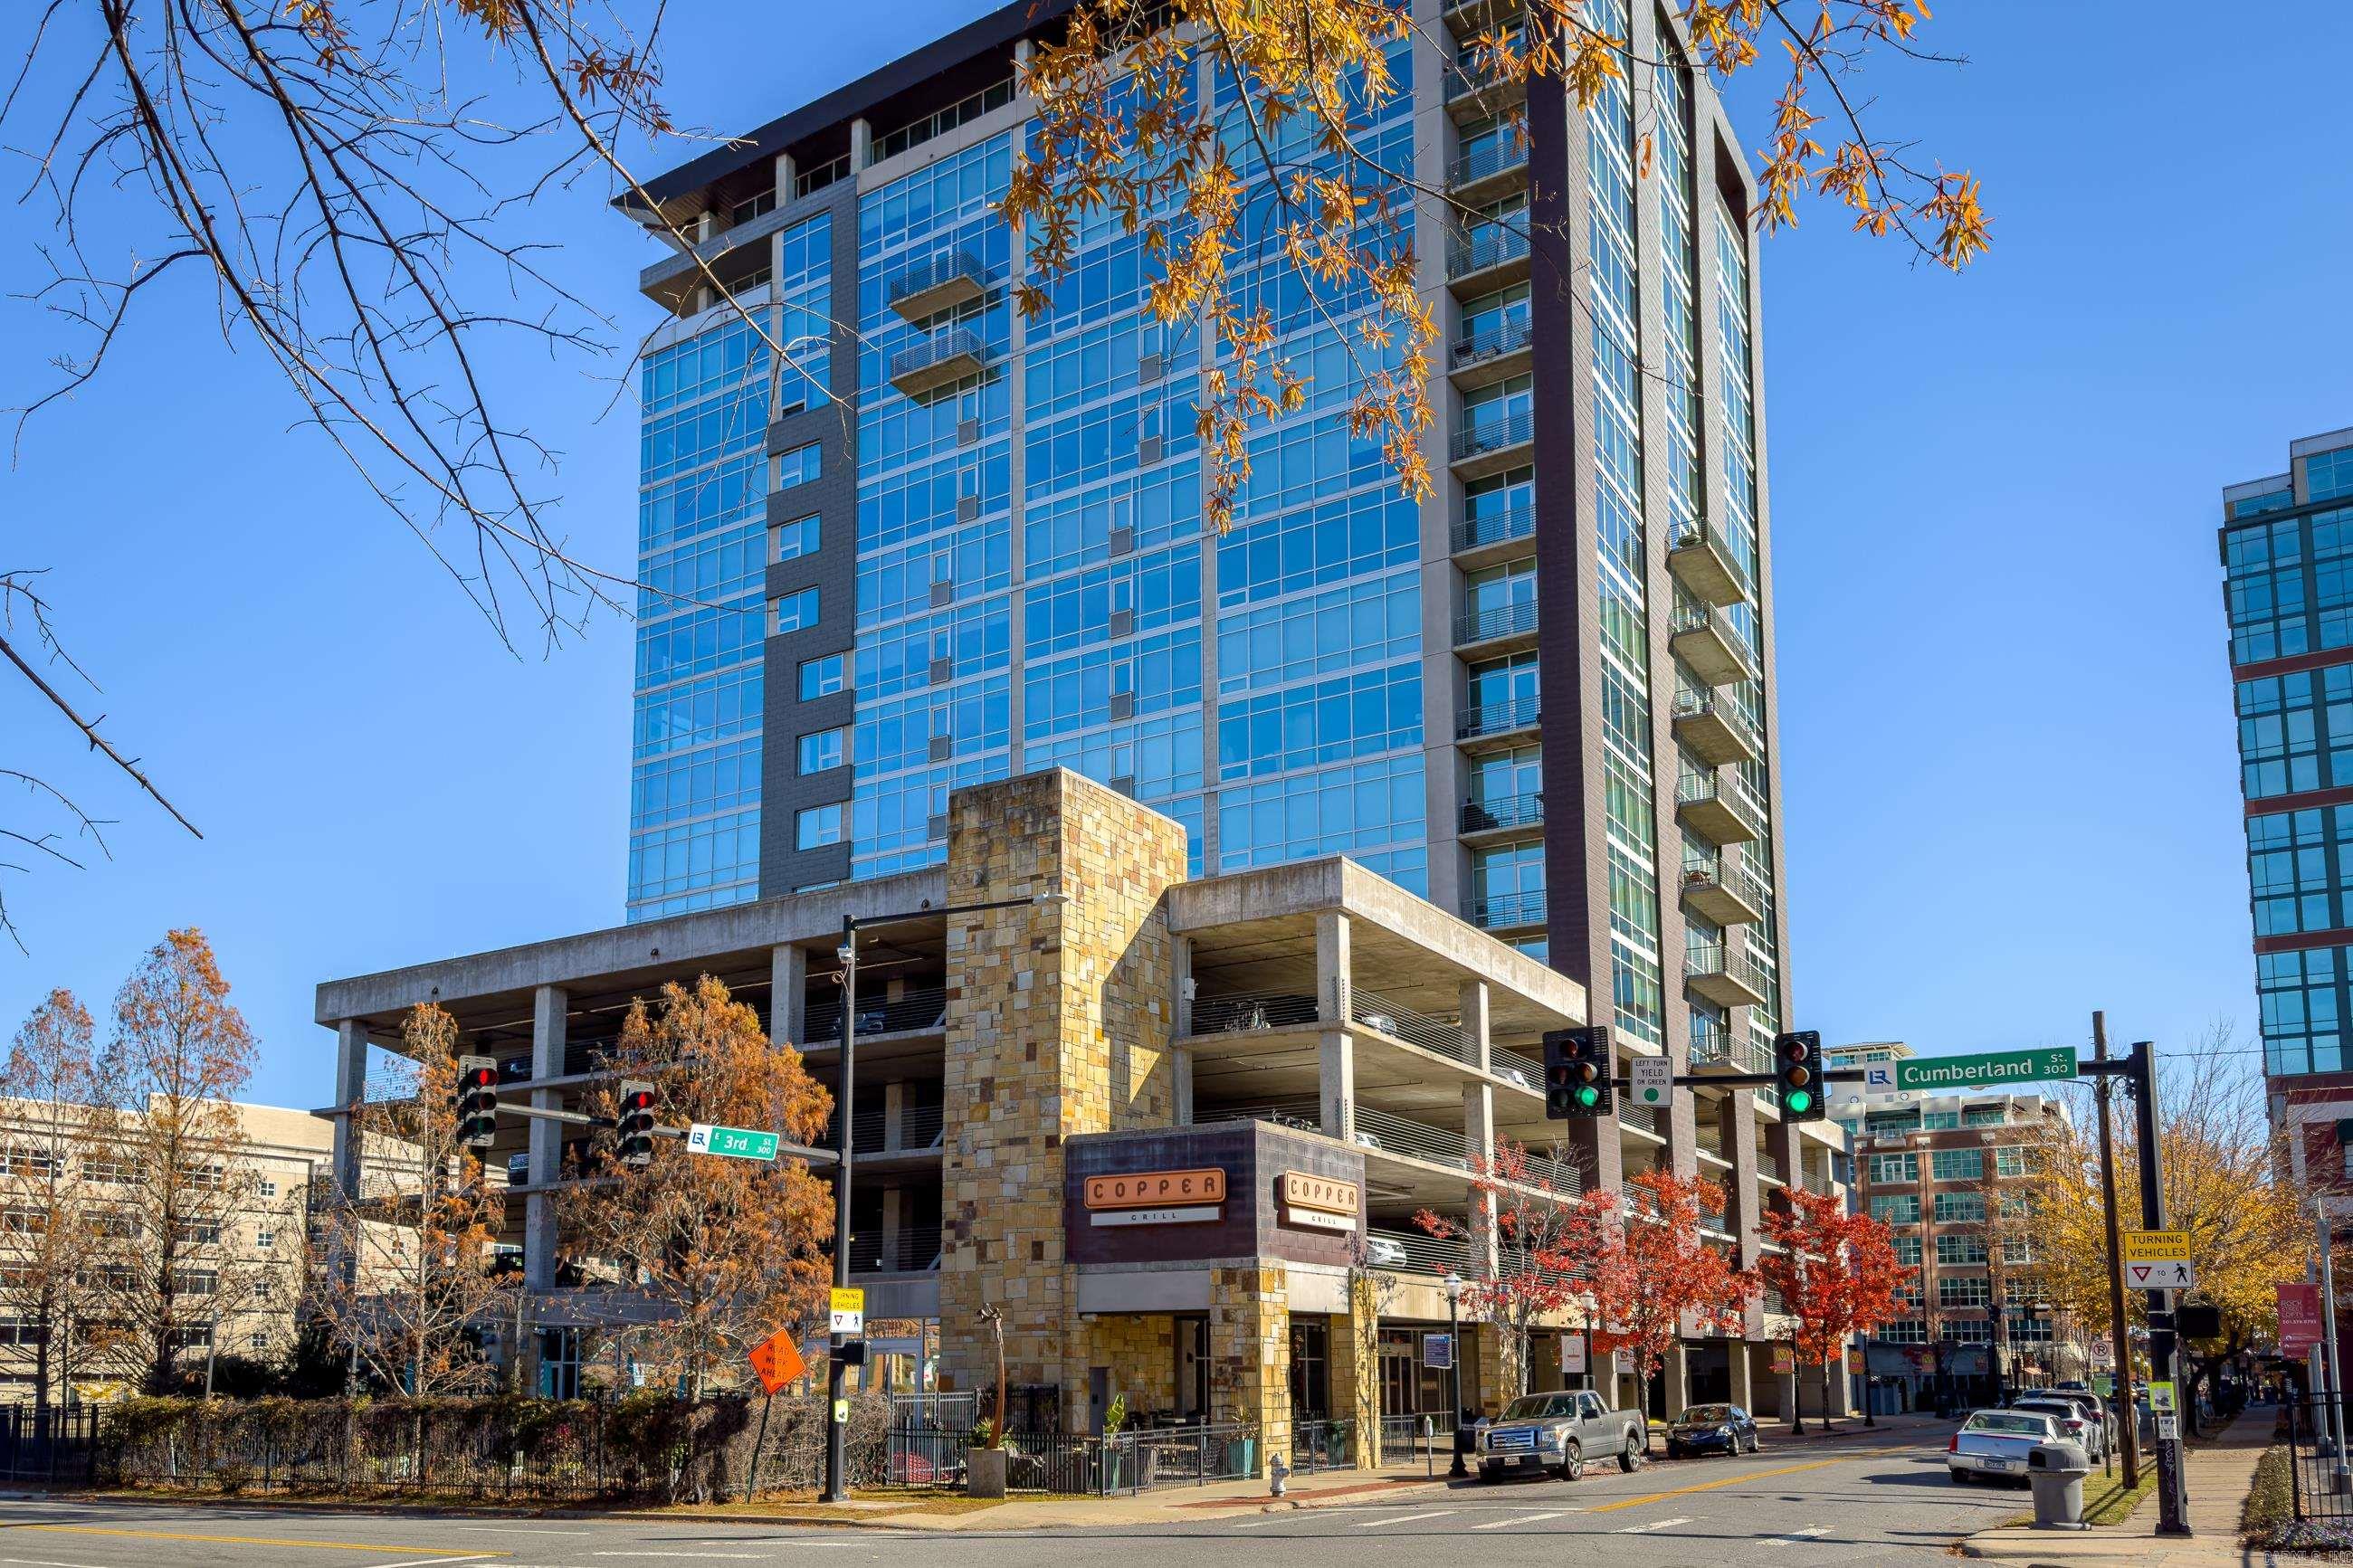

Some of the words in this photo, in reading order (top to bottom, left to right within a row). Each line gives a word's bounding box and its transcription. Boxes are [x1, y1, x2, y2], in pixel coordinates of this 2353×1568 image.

[2050, 1053, 2069, 1063] St.
[1641, 1069, 1663, 1077] YIELD
[1904, 1059, 2034, 1083] Cumberland
[2043, 1064, 2069, 1075] 300
[714, 1132, 720, 1140] E
[756, 1145, 772, 1155] 300
[1093, 1176, 1215, 1199] COPPER
[1291, 1179, 1355, 1206] COPPER
[1131, 1212, 1176, 1221] GRILL
[1311, 1215, 1337, 1225] GRILL
[2131, 1234, 2183, 1245] TURNING
[2129, 1247, 2186, 1258] VEHICLES
[834, 1292, 860, 1300] TURNING
[767, 1344, 790, 1355] ROAD
[766, 1355, 788, 1366] WORK
[760, 1367, 787, 1380] AHEAD
